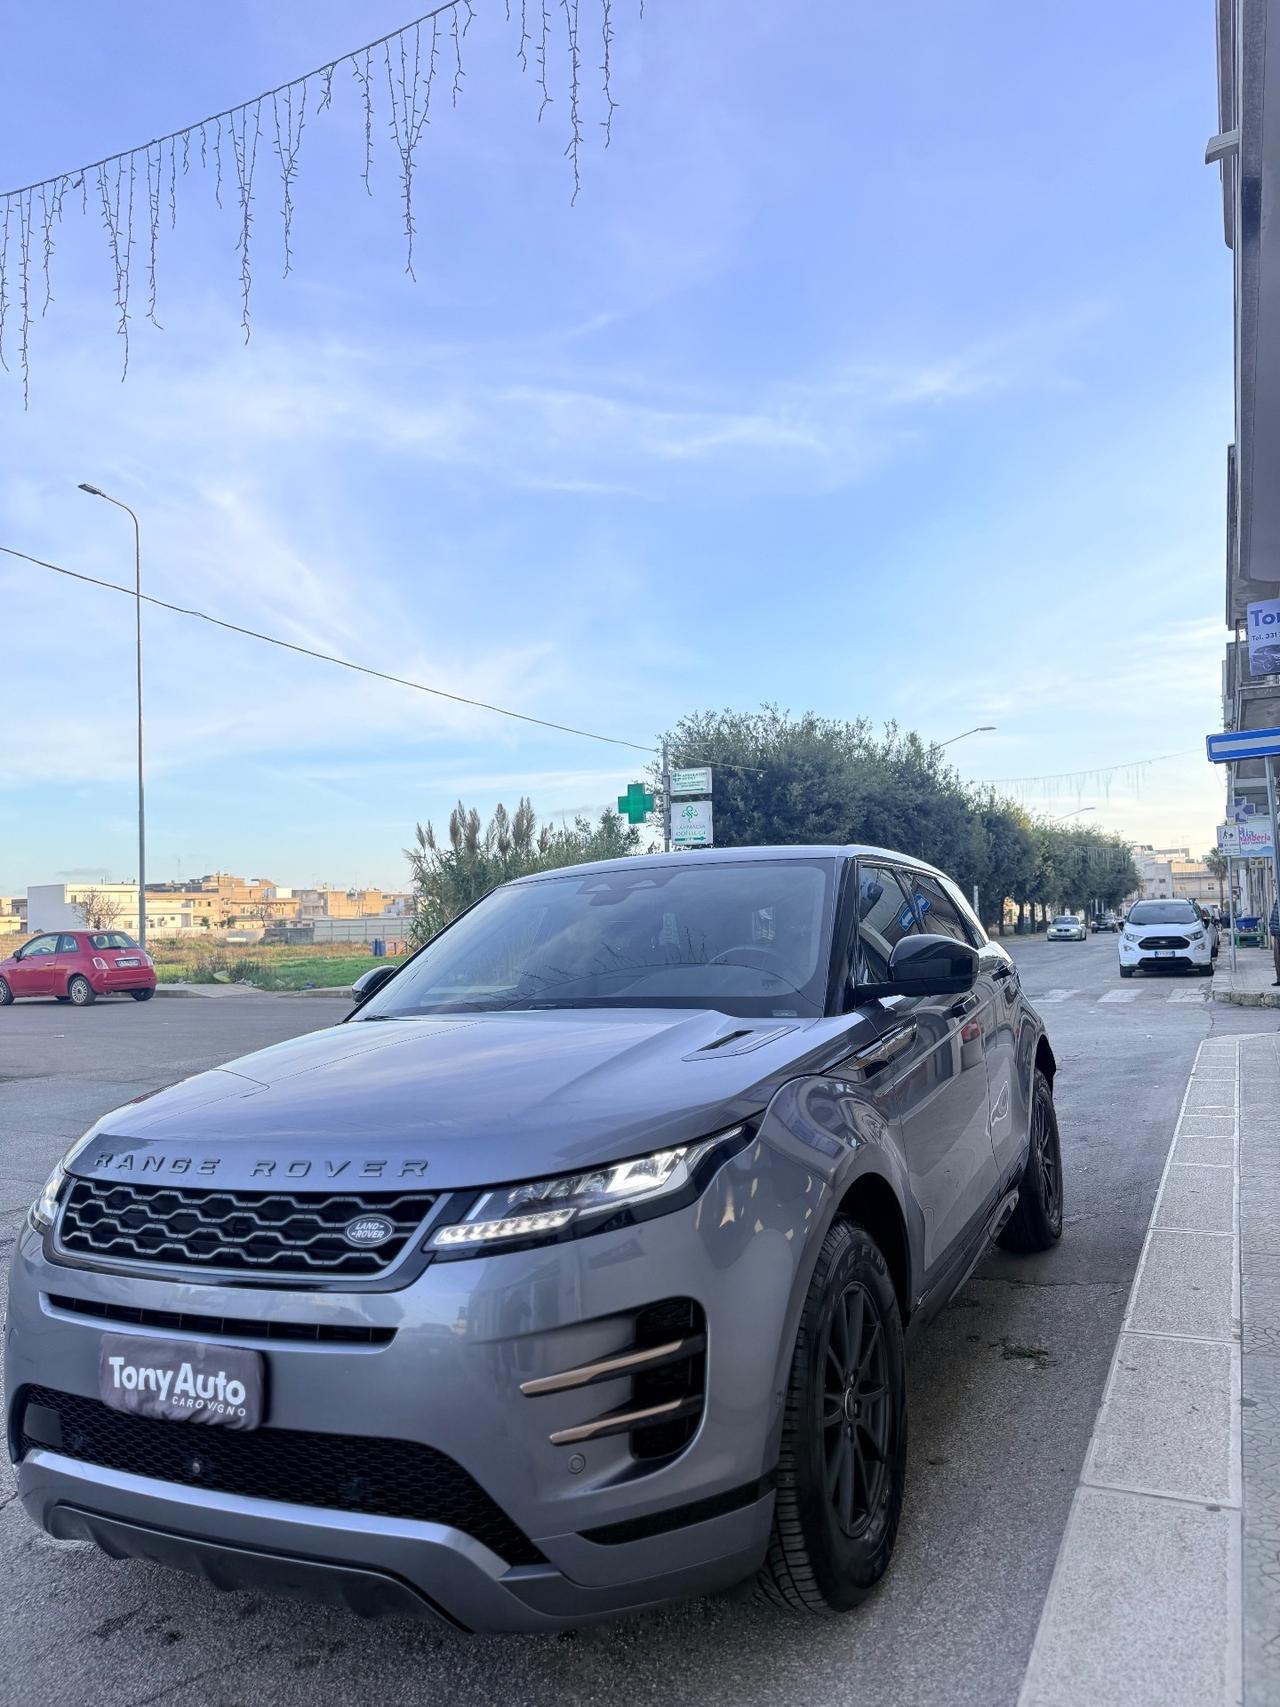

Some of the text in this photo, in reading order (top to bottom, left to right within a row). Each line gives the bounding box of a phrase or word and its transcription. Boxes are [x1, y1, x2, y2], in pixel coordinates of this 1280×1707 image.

[94, 1152, 429, 1178] RANGE ROVER
[172, 1396, 246, 1417] CAROVIGNO
